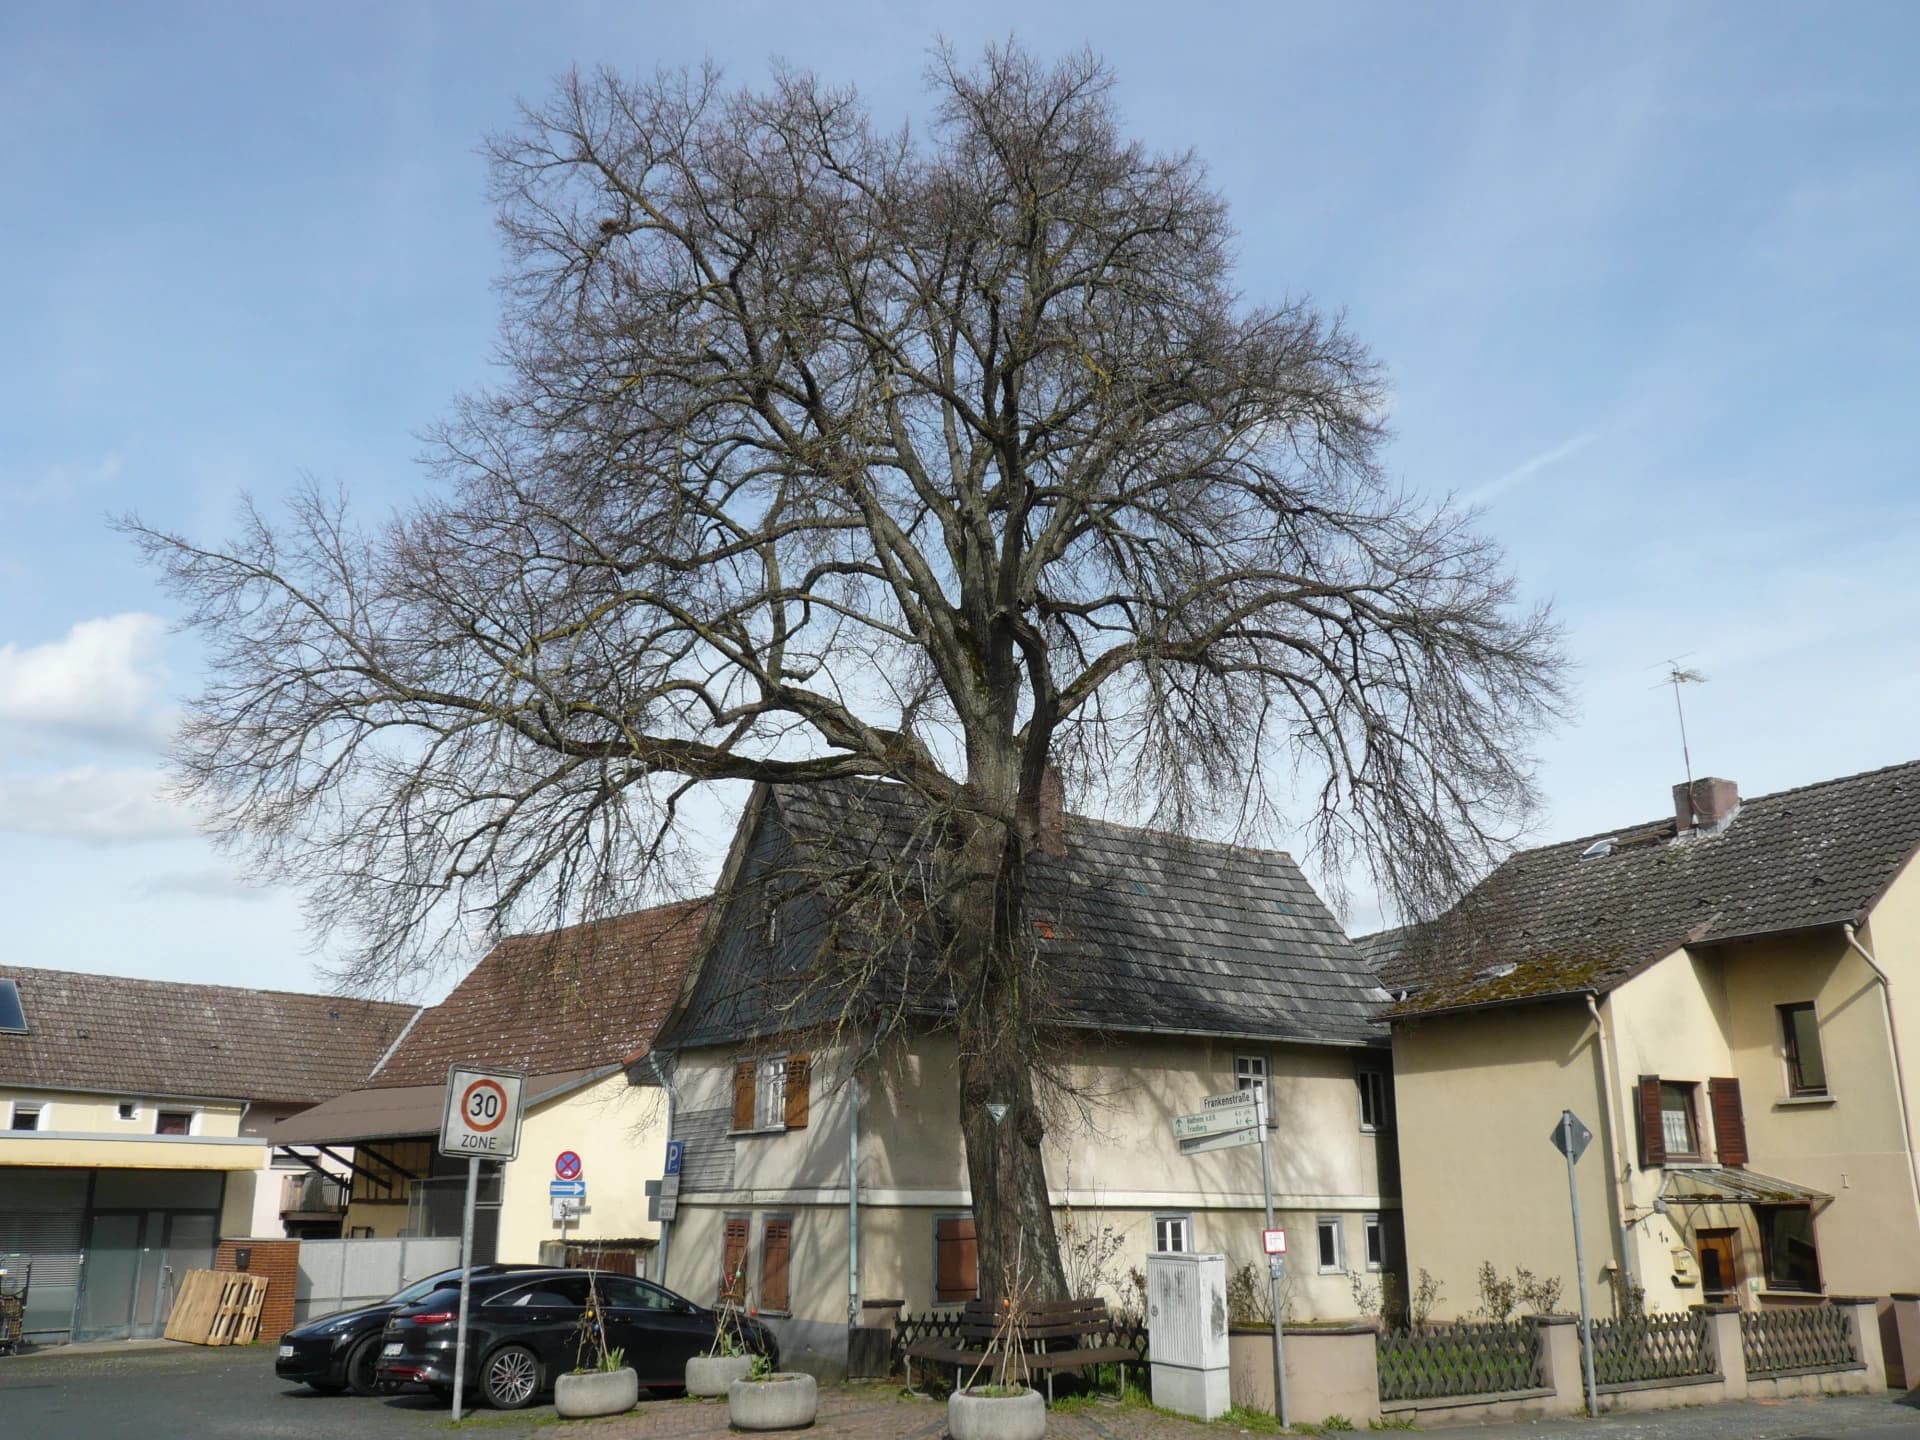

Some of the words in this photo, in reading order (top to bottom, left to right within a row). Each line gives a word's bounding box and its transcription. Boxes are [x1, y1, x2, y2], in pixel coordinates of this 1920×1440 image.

[470, 1093, 497, 1118] 30
[1204, 1092, 1250, 1109] Frankenstraße
[461, 1134, 497, 1150] ZONE
[668, 1145, 679, 1171] P
